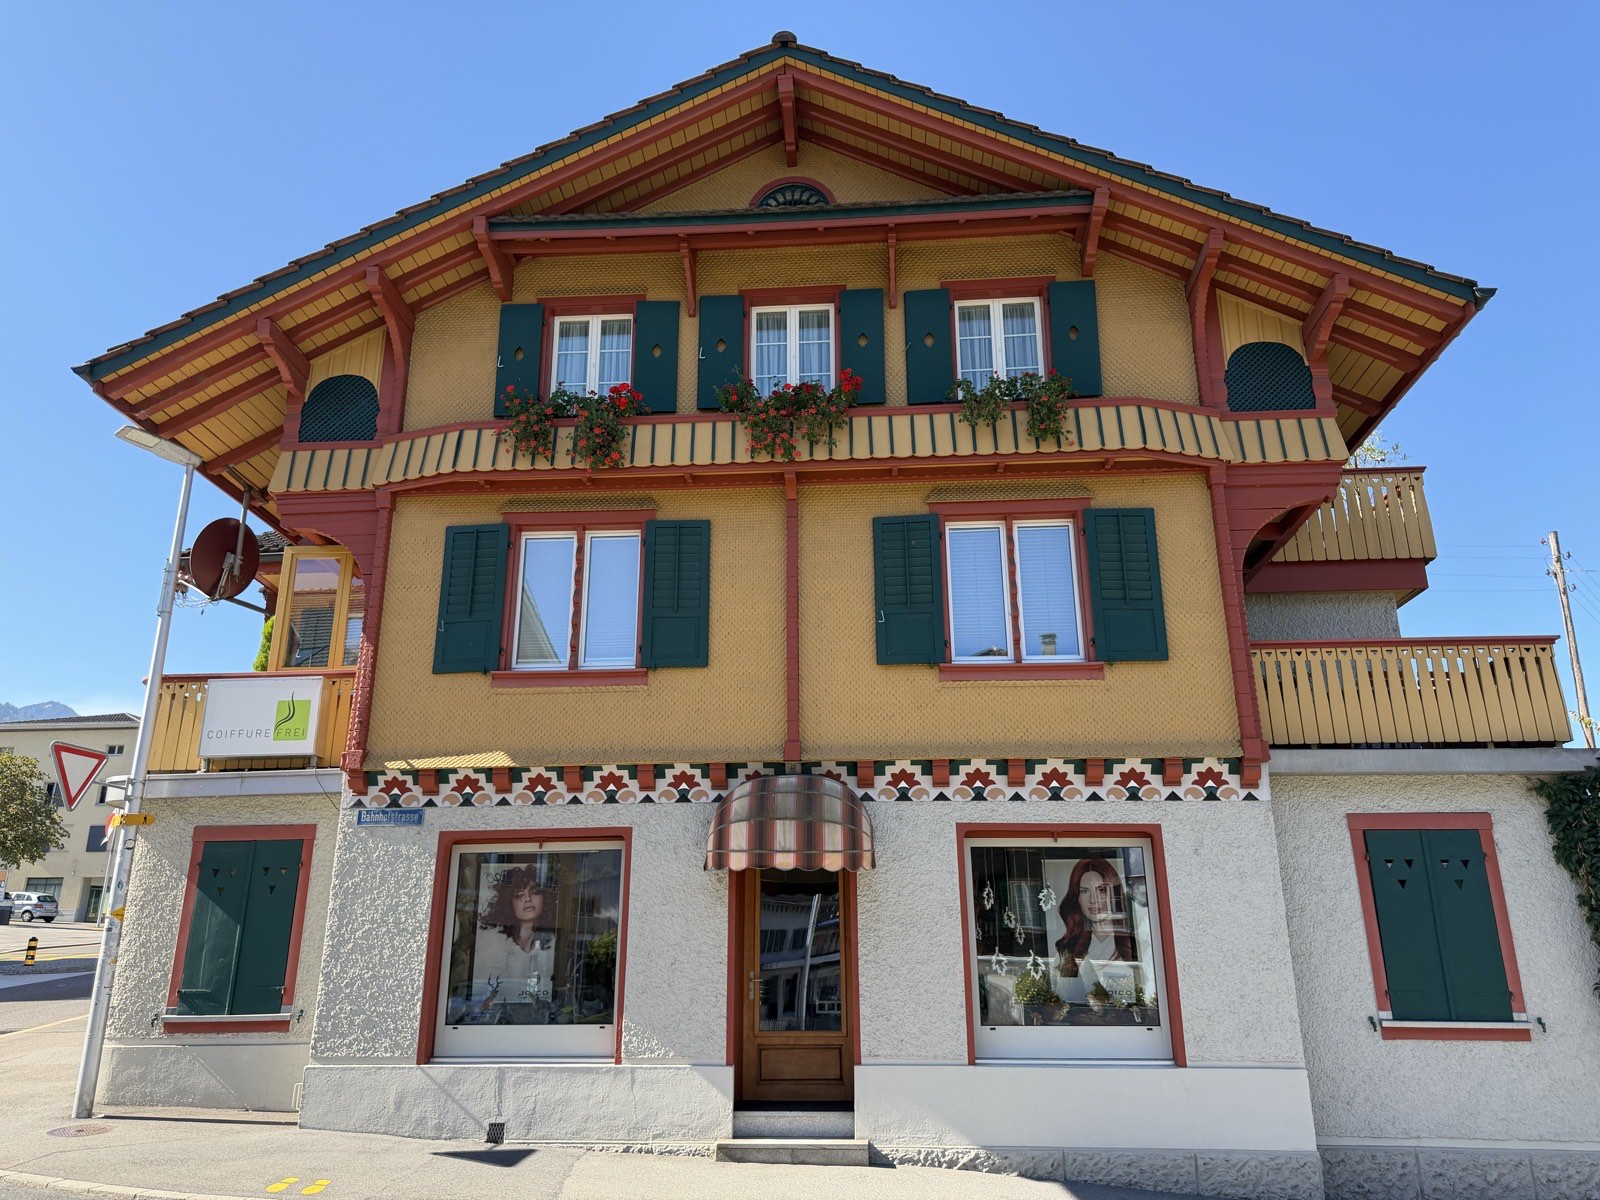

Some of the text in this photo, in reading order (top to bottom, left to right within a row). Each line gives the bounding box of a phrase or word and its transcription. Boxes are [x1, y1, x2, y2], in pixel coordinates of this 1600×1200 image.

[206, 727, 305, 740] COIFFURE FREI
[360, 810, 419, 822] Bahnhofstrasse
